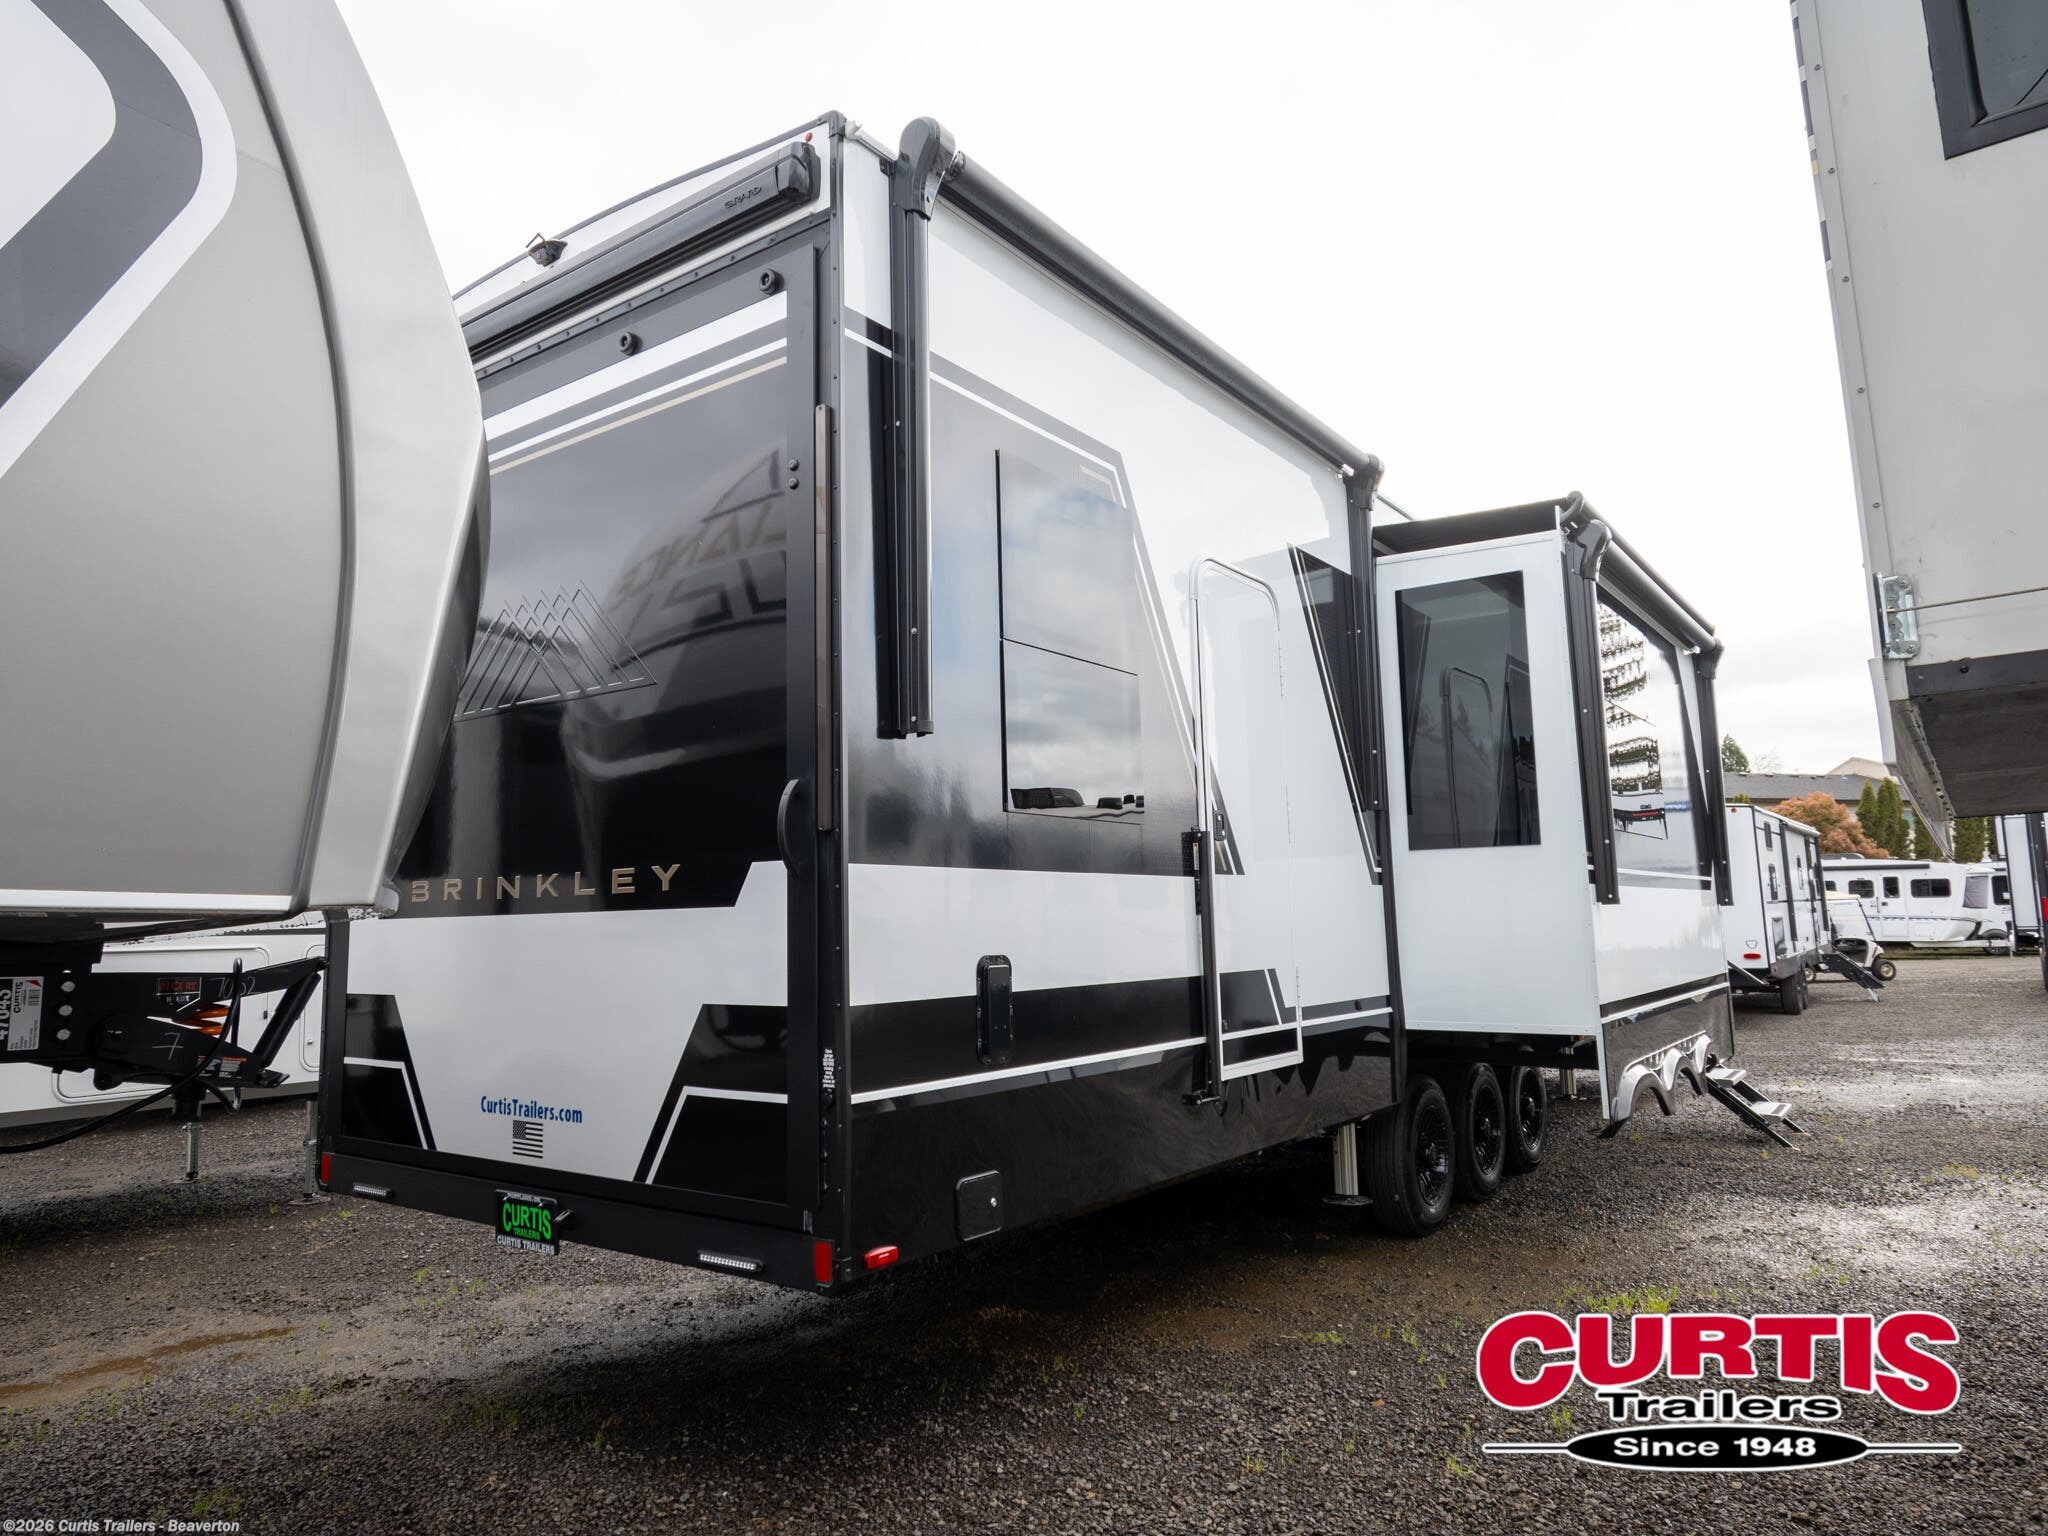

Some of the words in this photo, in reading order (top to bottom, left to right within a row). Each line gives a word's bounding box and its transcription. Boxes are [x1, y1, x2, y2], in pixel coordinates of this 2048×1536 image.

[411, 864, 681, 903] BRINKLEY
[13, 981, 24, 1014] CURTIS
[480, 1096, 583, 1124] CurtisTrailers.com
[502, 1202, 552, 1240] CURTIS
[513, 1227, 541, 1241] TRAILERS
[497, 1235, 521, 1249] CURTIS
[522, 1239, 556, 1256] TRAILERS
